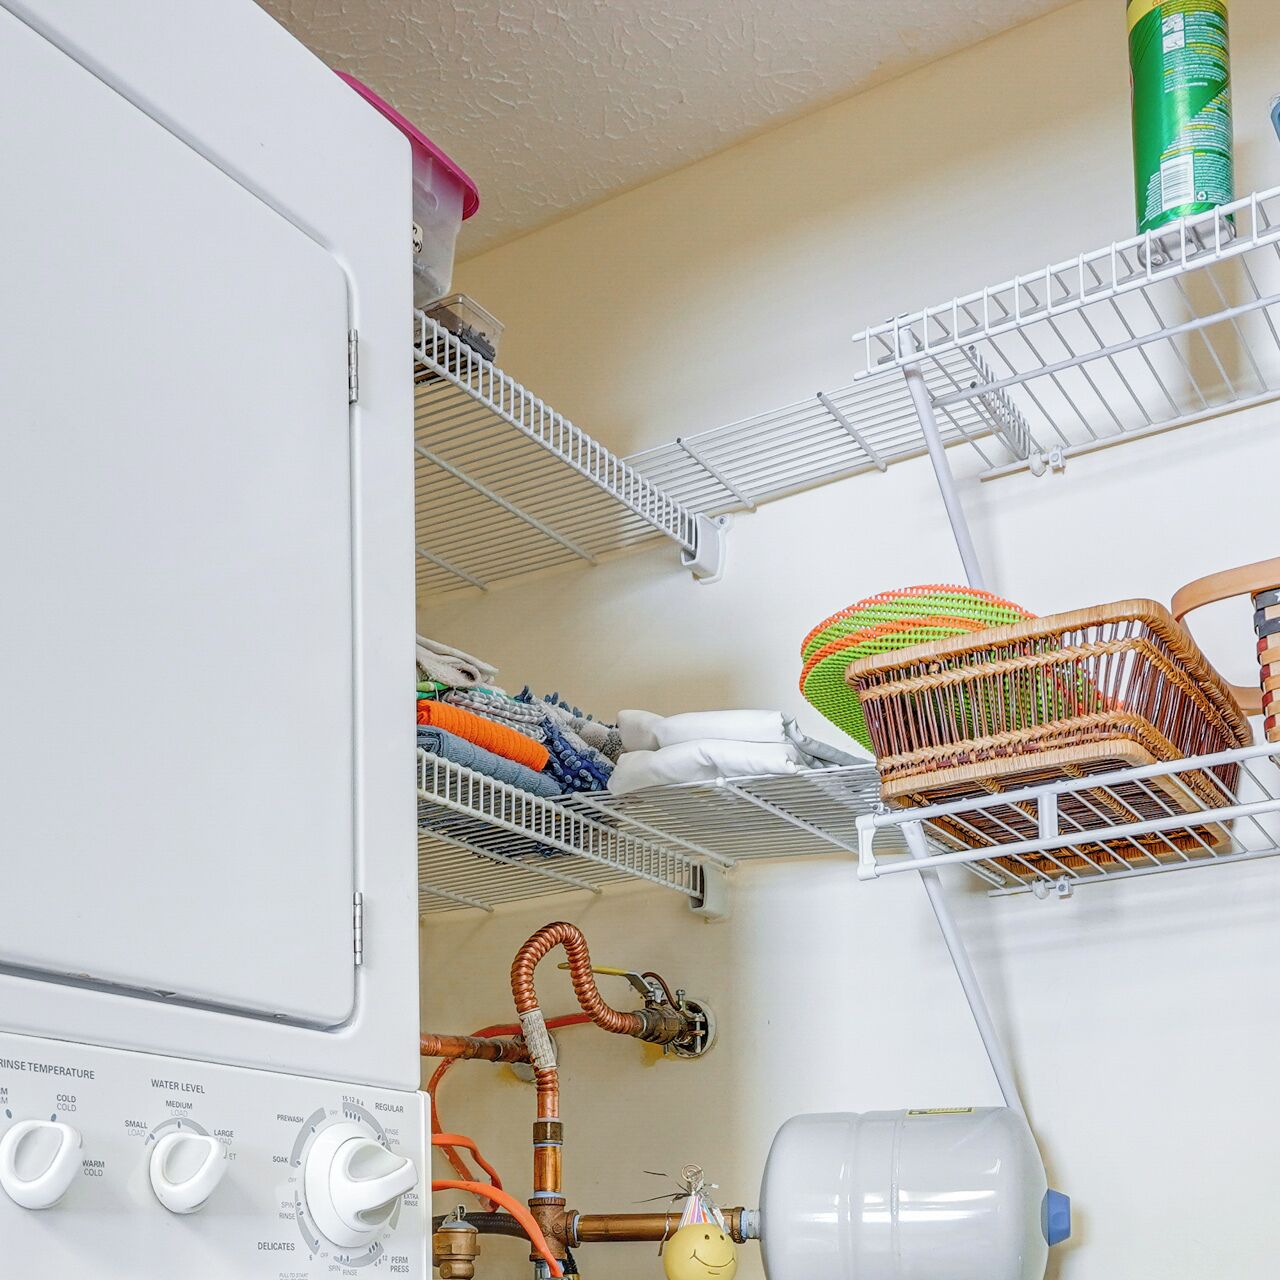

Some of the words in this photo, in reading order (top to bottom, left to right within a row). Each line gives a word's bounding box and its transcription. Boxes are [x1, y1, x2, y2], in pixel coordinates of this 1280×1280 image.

[27, 1062, 96, 1080] TEMPERATURE
[150, 1078, 180, 1091] WATER
[181, 1082, 206, 1094] LEVEL
[56, 1094, 77, 1103] COLD
[56, 1103, 77, 1112] COLD
[165, 1100, 193, 1110] MEDIUM
[375, 1102, 404, 1113] REGULAR
[276, 1114, 304, 1123] PREWASH
[124, 1120, 148, 1130] SMALL
[127, 1128, 146, 1138] LOAD
[213, 1129, 234, 1138] LARGE
[384, 1128, 400, 1136] RINSE
[216, 1137, 232, 1146] OAD
[82, 1160, 105, 1168] WARM
[83, 1168, 104, 1177] COLD
[278, 1212, 296, 1220] RINSE
[257, 1242, 296, 1251] DELICATES
[390, 1256, 409, 1264] PERM
[390, 1265, 410, 1273] PRESS
